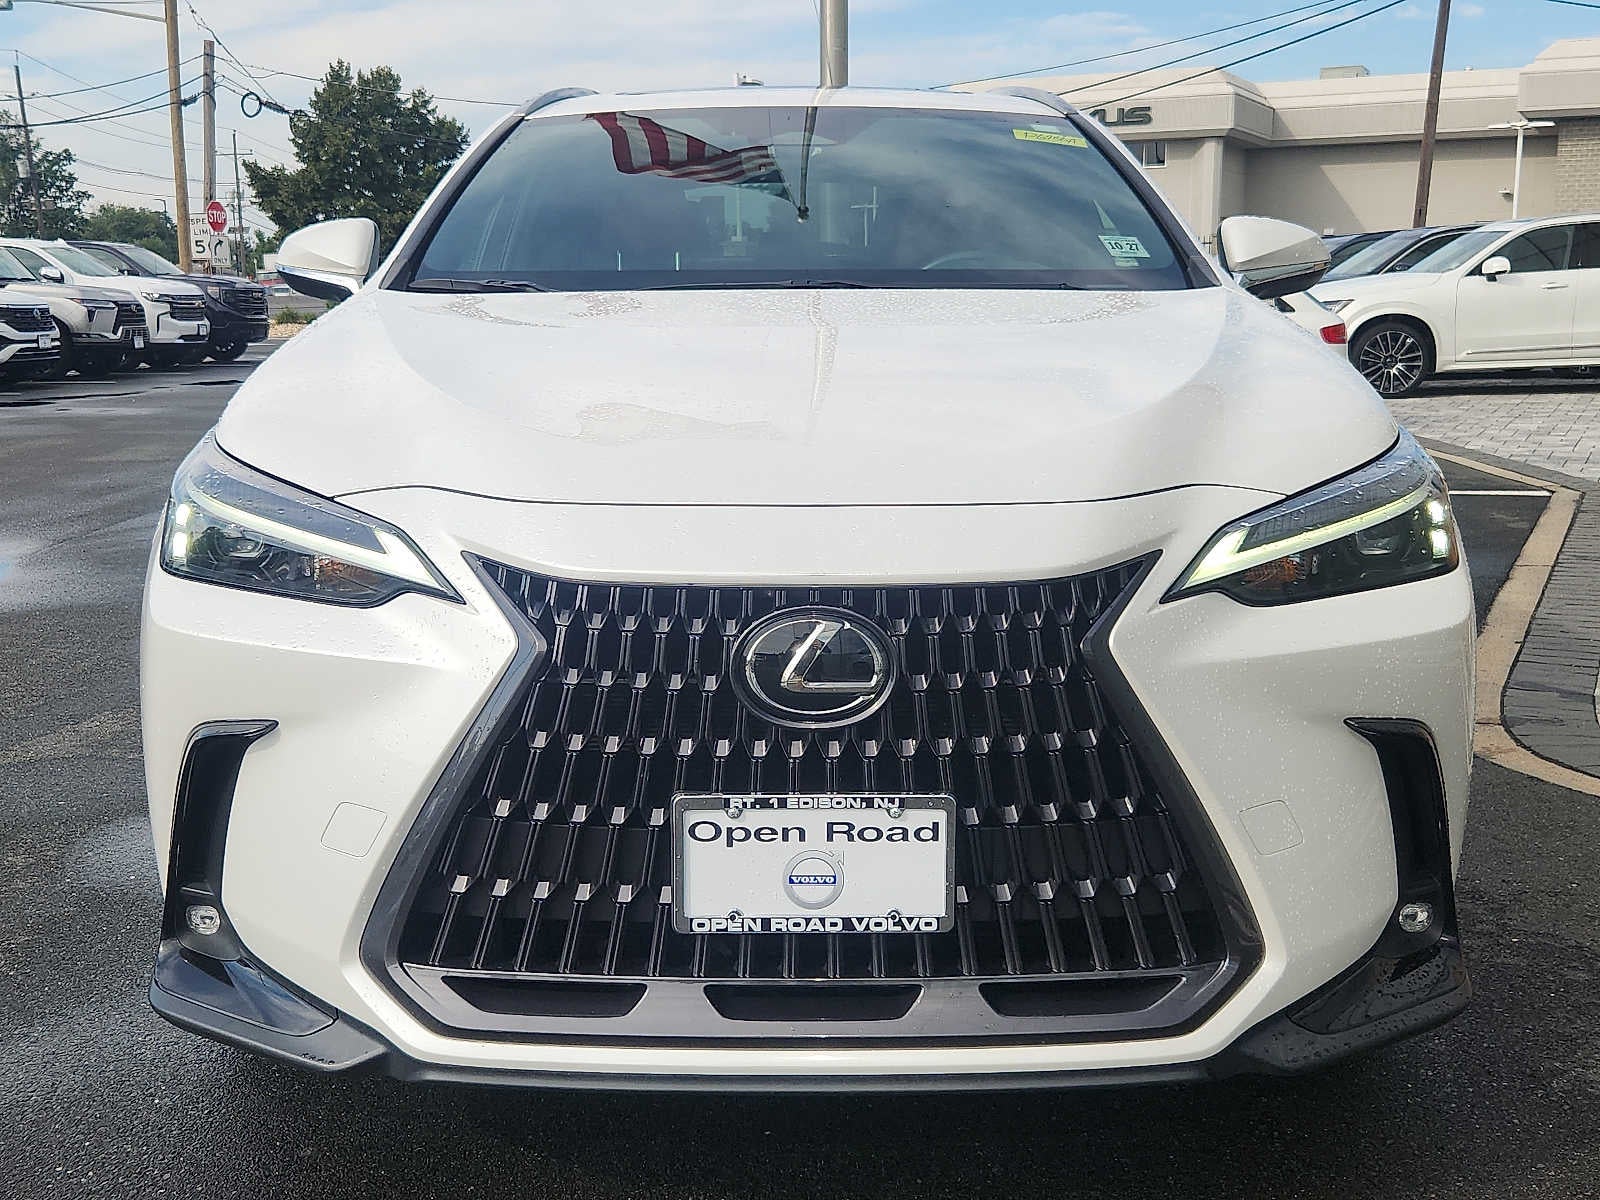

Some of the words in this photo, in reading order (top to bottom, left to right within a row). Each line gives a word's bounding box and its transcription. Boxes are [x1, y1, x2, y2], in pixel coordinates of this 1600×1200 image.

[208, 210, 226, 223] STOP
[1108, 241, 1124, 250] 10
[1126, 242, 1140, 251] 27
[213, 256, 228, 264] ONLY
[729, 798, 760, 809] RT.
[769, 798, 778, 809] 1
[786, 798, 867, 809] EDISON,
[873, 798, 900, 809] NJ
[687, 820, 807, 847] Open
[826, 821, 941, 843] Road
[790, 875, 835, 884] VOLVO
[692, 918, 762, 932] OPEN
[770, 917, 843, 932] ROAD
[851, 917, 938, 932] VOLVO
